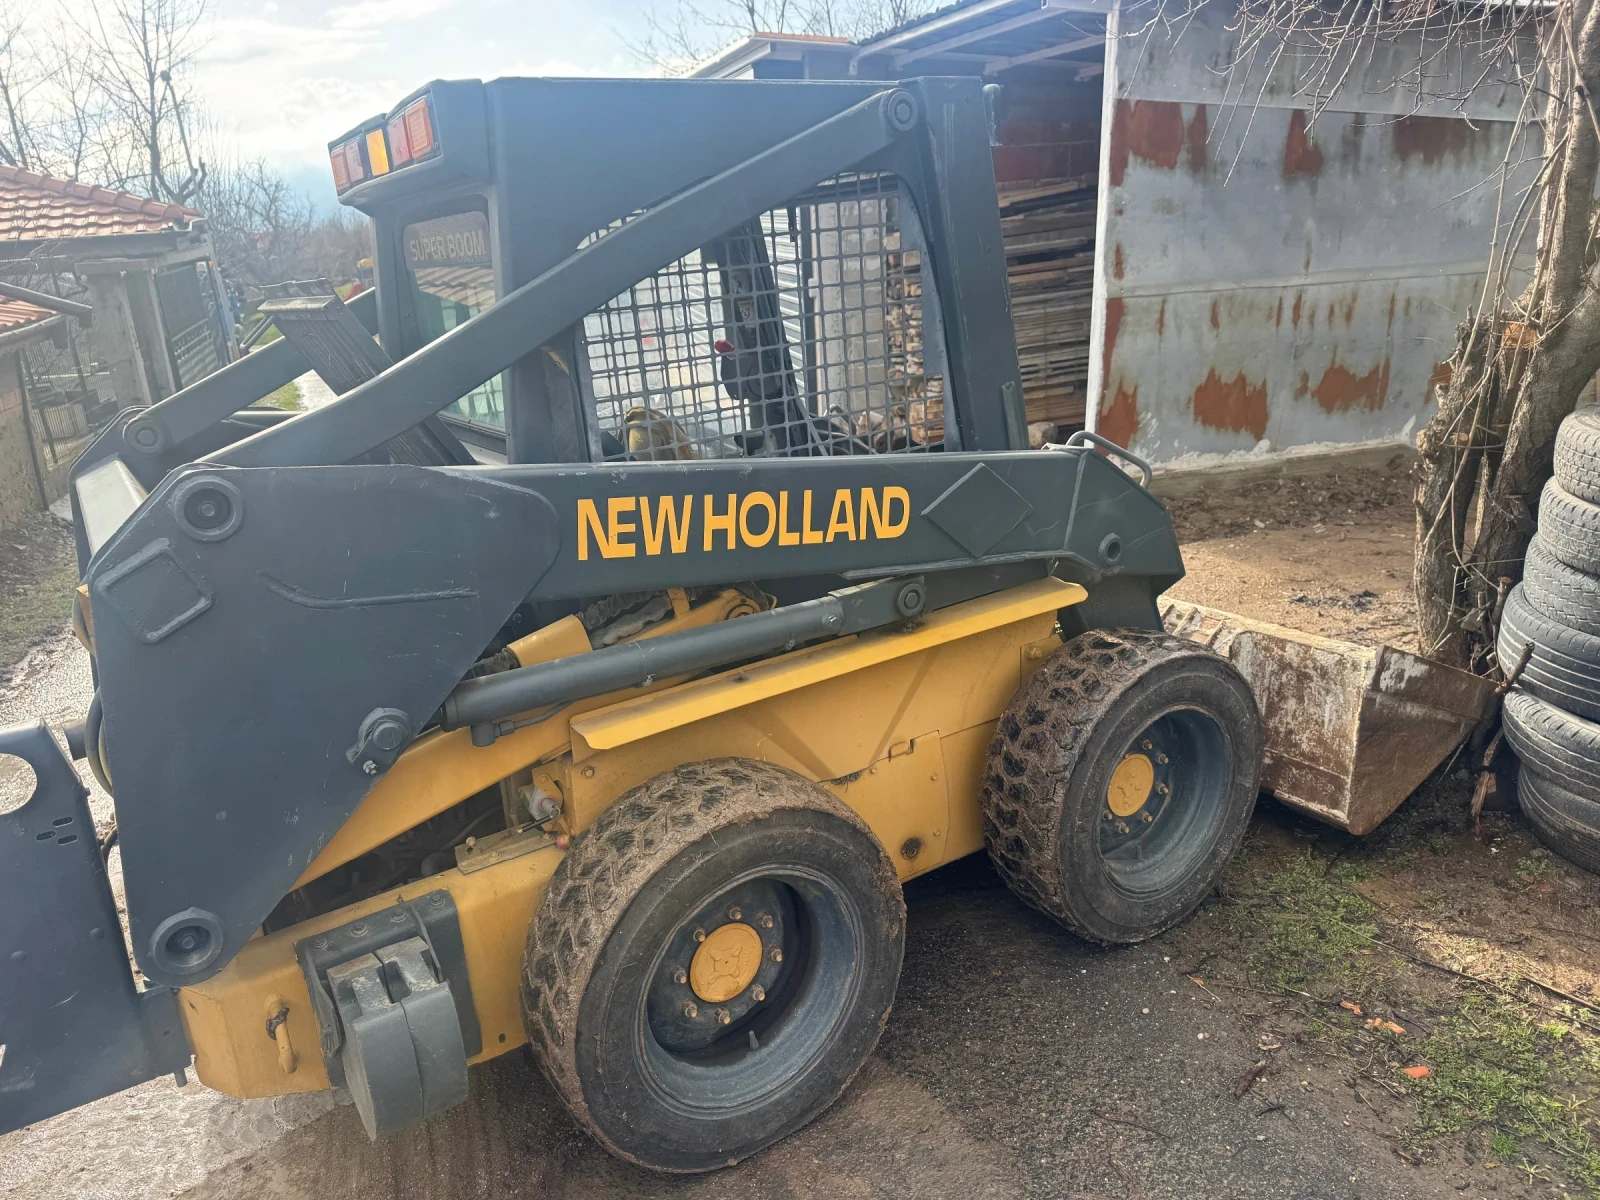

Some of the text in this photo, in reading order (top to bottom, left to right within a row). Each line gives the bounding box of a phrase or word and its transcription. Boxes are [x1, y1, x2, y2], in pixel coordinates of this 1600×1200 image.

[410, 230, 485, 261] SUPER BOOM
[577, 486, 911, 561] NEW HOLLAND
